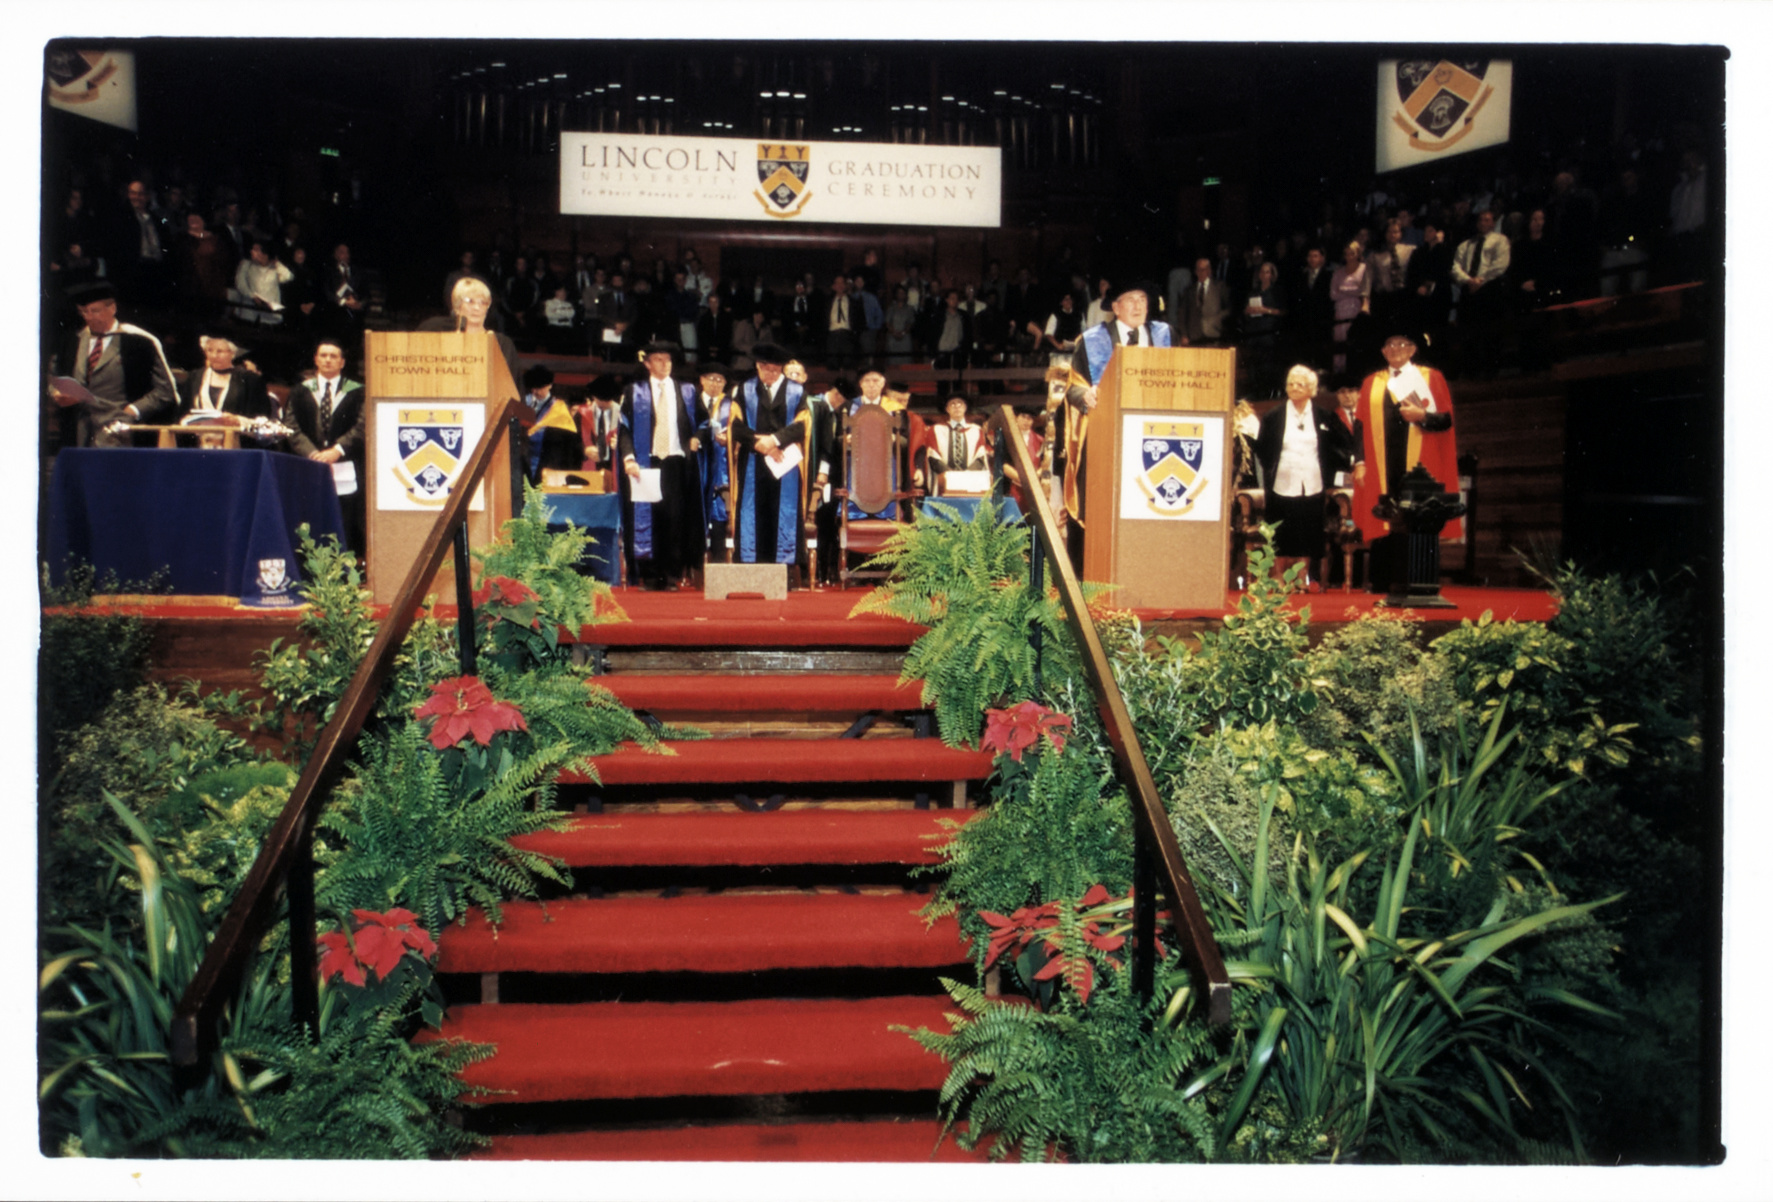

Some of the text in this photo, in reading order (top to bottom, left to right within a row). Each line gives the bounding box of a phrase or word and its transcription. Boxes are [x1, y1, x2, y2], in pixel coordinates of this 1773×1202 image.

[581, 145, 737, 172] LINCOLN
[828, 160, 981, 180] GRADUATION
[582, 171, 737, 185] UNIVERSITY
[827, 181, 976, 200] CEREMONY
[374, 355, 485, 364] CHRISTCHURCH
[389, 366, 470, 375] TOWN HALL
[1125, 367, 1227, 379] CHRISTCHURCH
[1139, 379, 1213, 390] TOWN HALL
